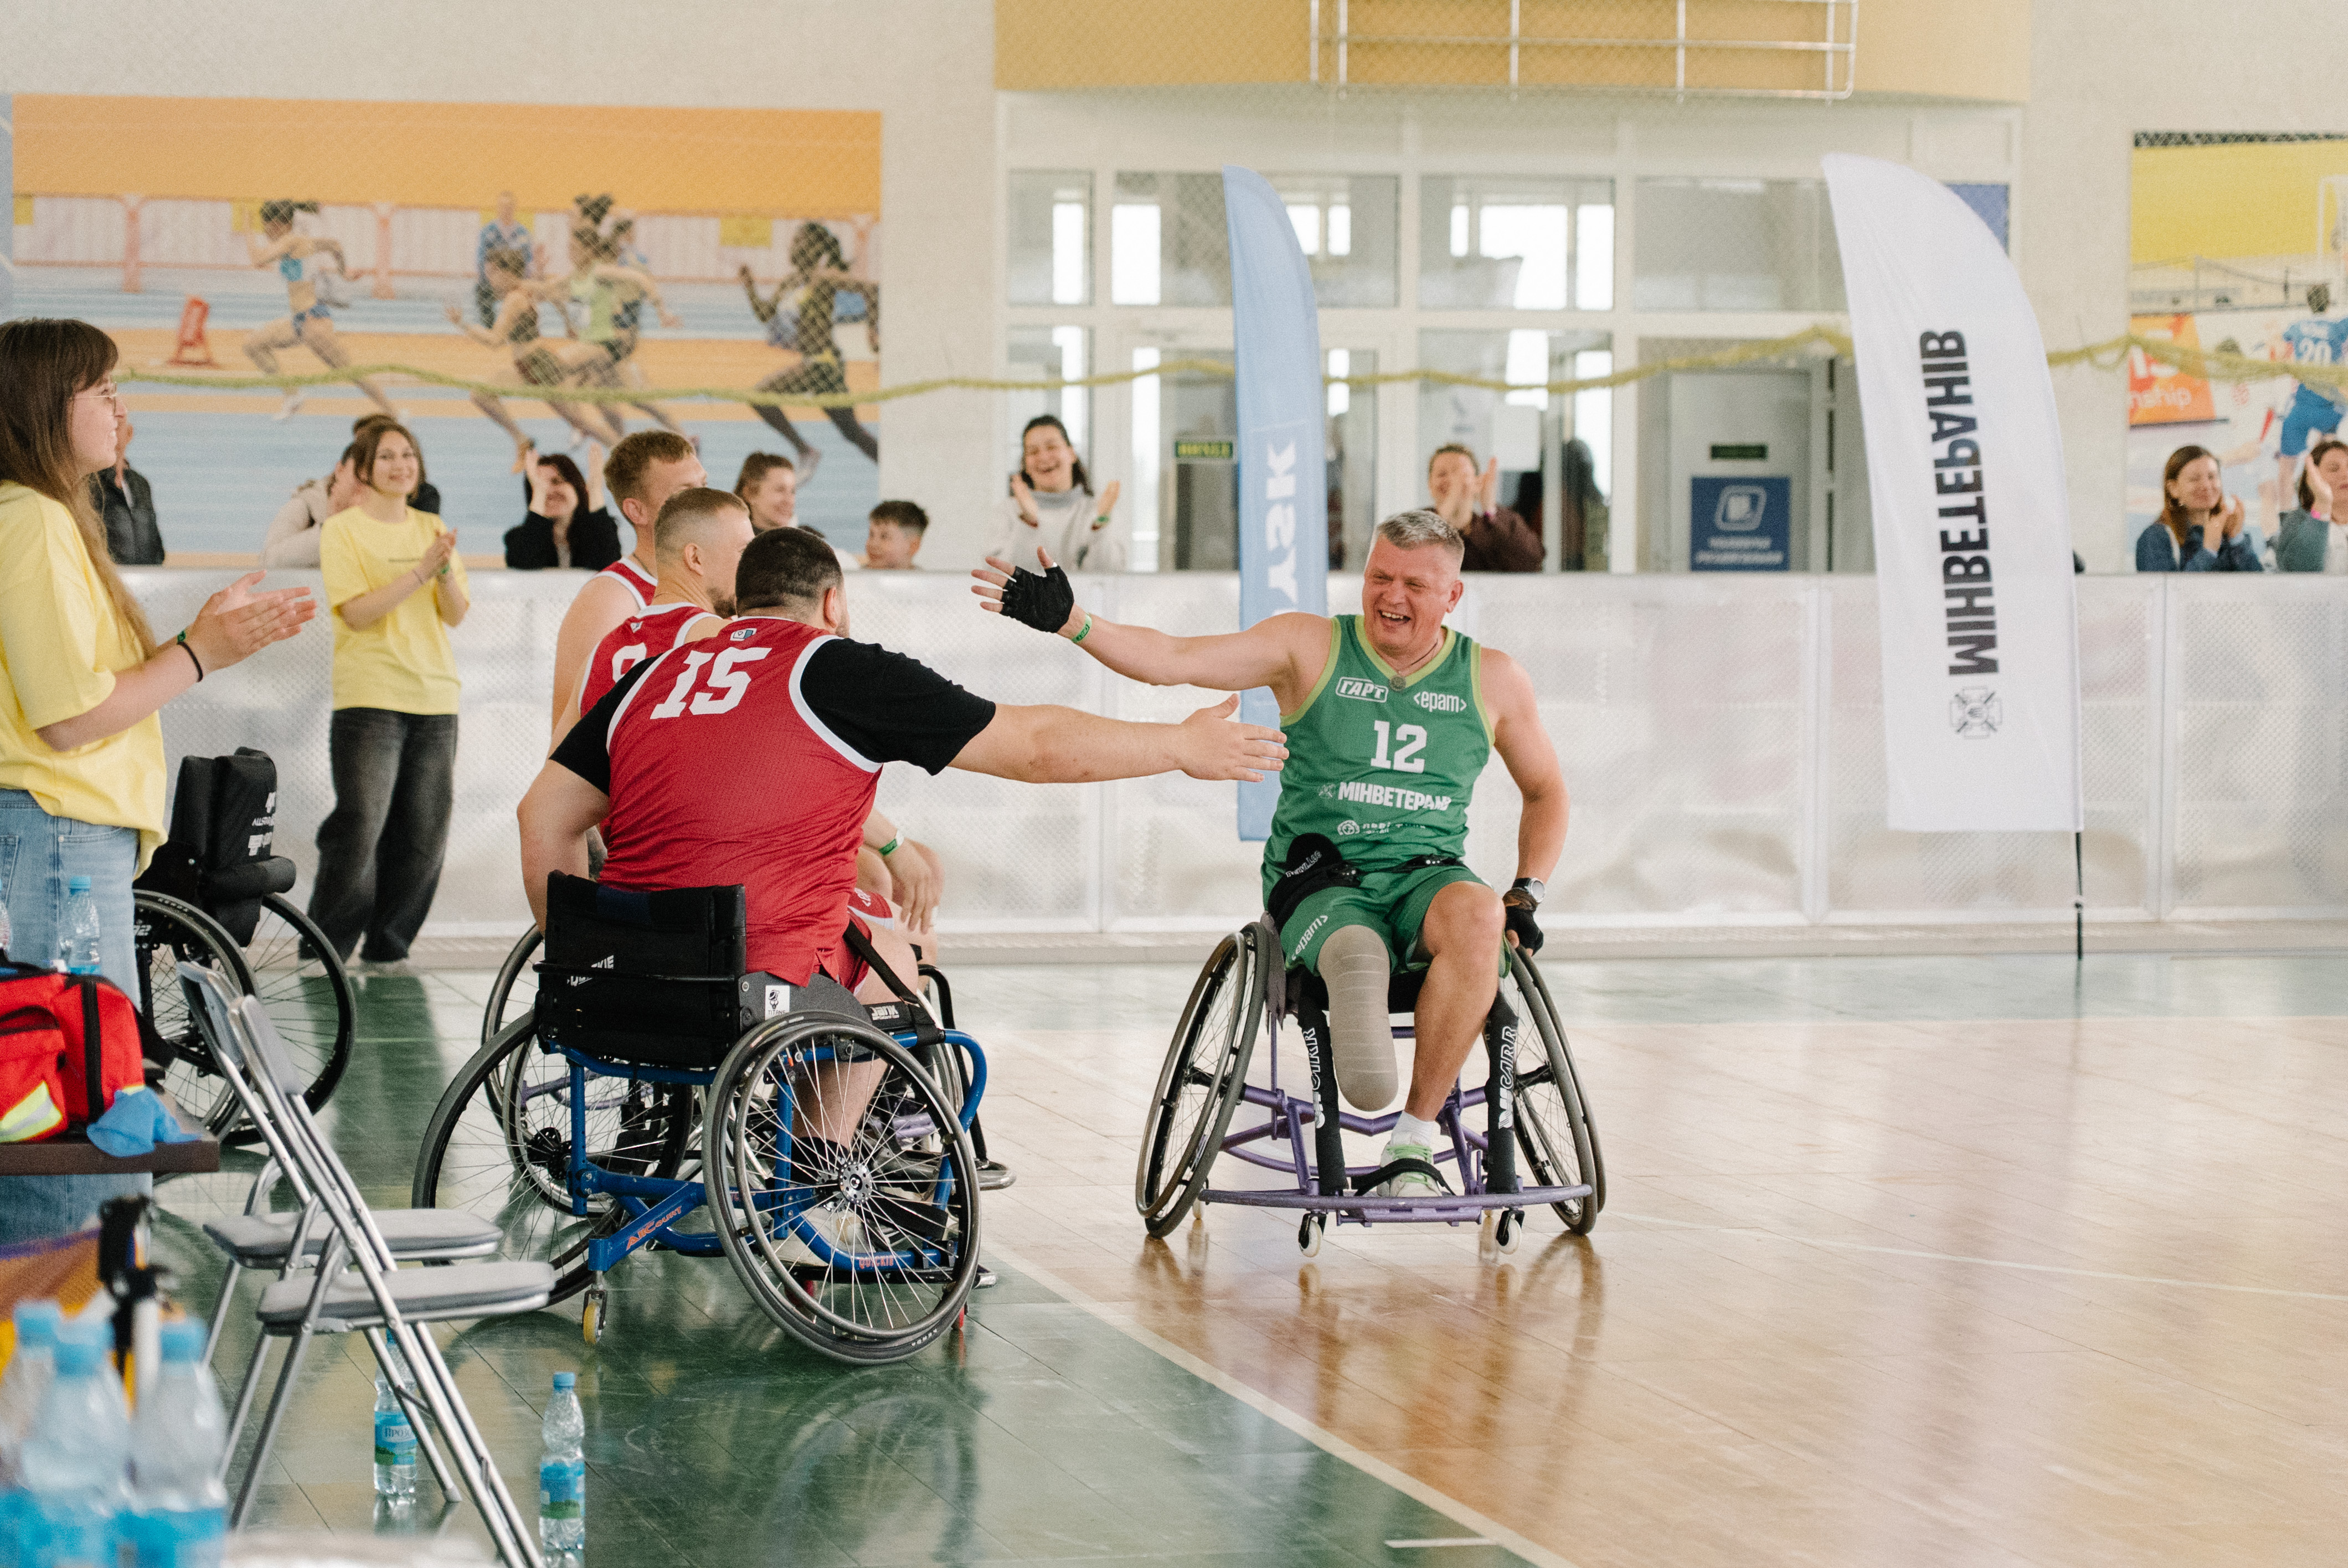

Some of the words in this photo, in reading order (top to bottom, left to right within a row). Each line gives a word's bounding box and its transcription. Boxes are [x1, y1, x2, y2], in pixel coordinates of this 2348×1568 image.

[650, 647, 773, 719] 15
[1340, 680, 1386, 699] ГАРТ
[1370, 720, 1428, 773] 12
